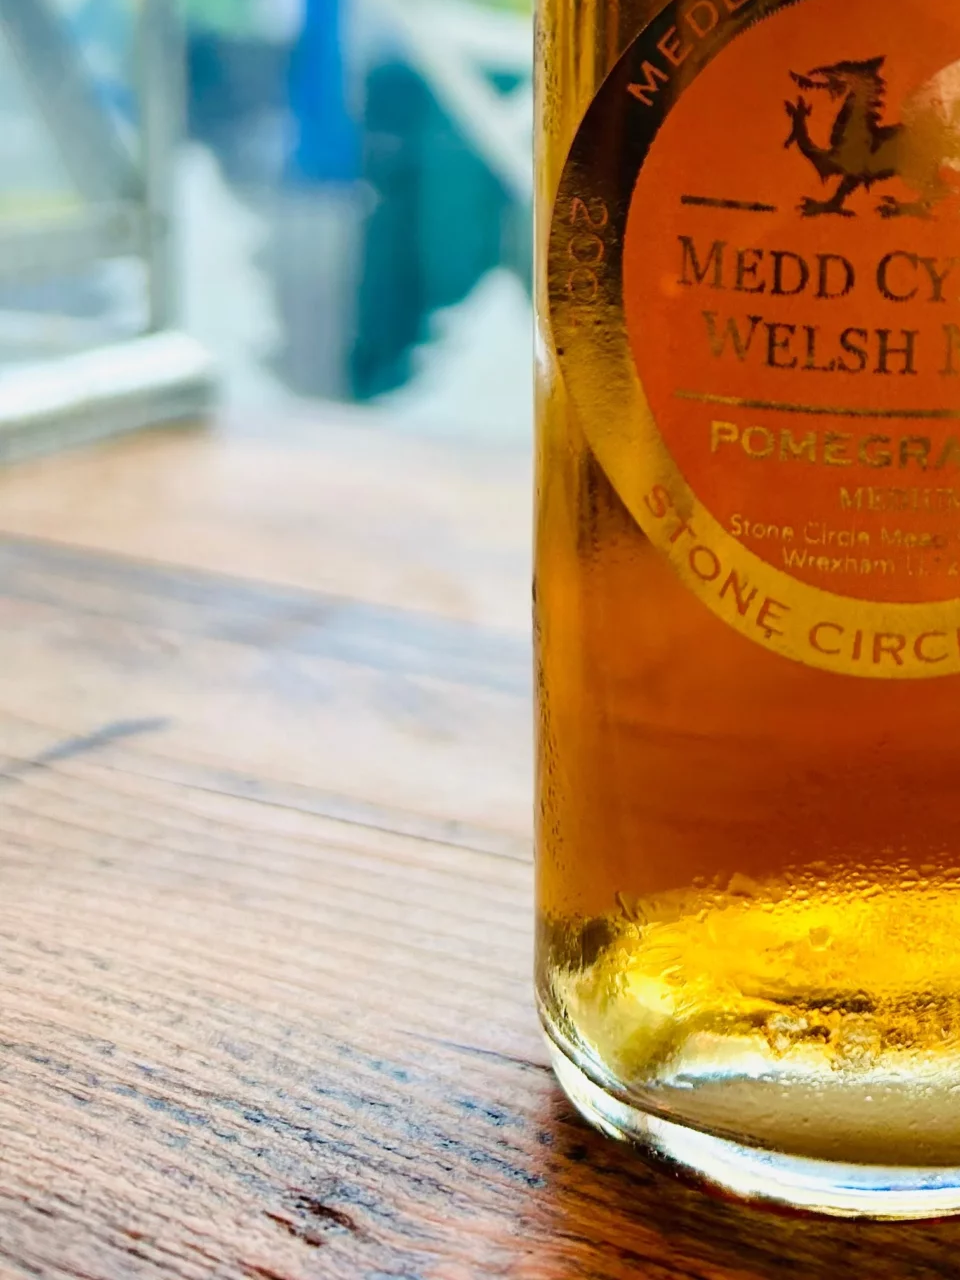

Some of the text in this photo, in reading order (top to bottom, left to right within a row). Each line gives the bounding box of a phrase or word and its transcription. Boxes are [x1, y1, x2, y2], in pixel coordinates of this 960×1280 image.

[676, 234, 856, 300] MEDD
[701, 310, 919, 375] WELSH
[730, 513, 795, 542] Stone
[643, 483, 792, 640] STONE
[782, 546, 896, 576] Wrexham
